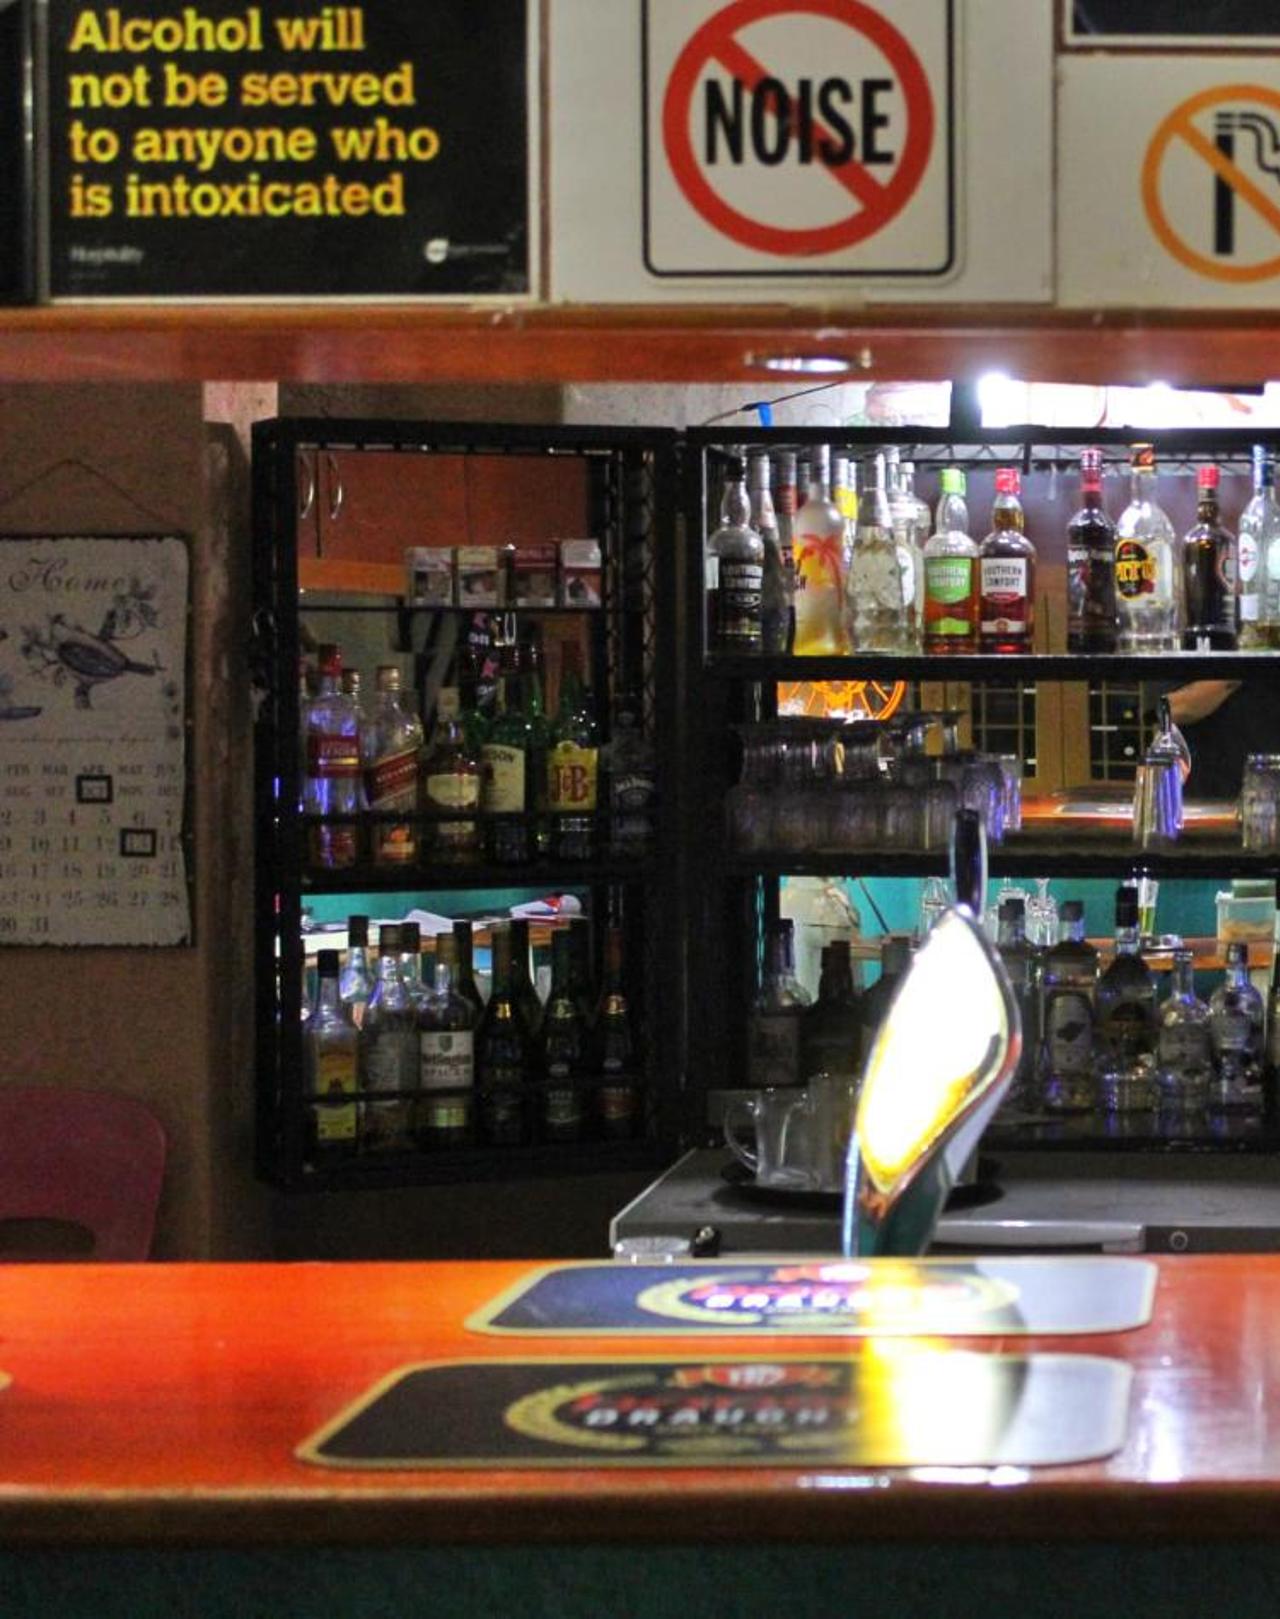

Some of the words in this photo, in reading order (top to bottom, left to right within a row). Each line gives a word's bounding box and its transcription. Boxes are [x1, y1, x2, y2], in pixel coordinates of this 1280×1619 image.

[69, 9, 263, 52] Alcohol
[277, 9, 364, 51] will
[69, 65, 152, 108] not
[163, 63, 228, 107] be
[241, 63, 415, 107] served
[69, 120, 119, 162] to
[133, 127, 317, 171] anyone
[330, 118, 439, 161] who
[704, 76, 895, 168] NOISE
[70, 175, 112, 218] is
[126, 173, 405, 217] intoxicated
[984, 565, 1022, 578] SOUTHERN
[985, 577, 1020, 588] COMFORT
